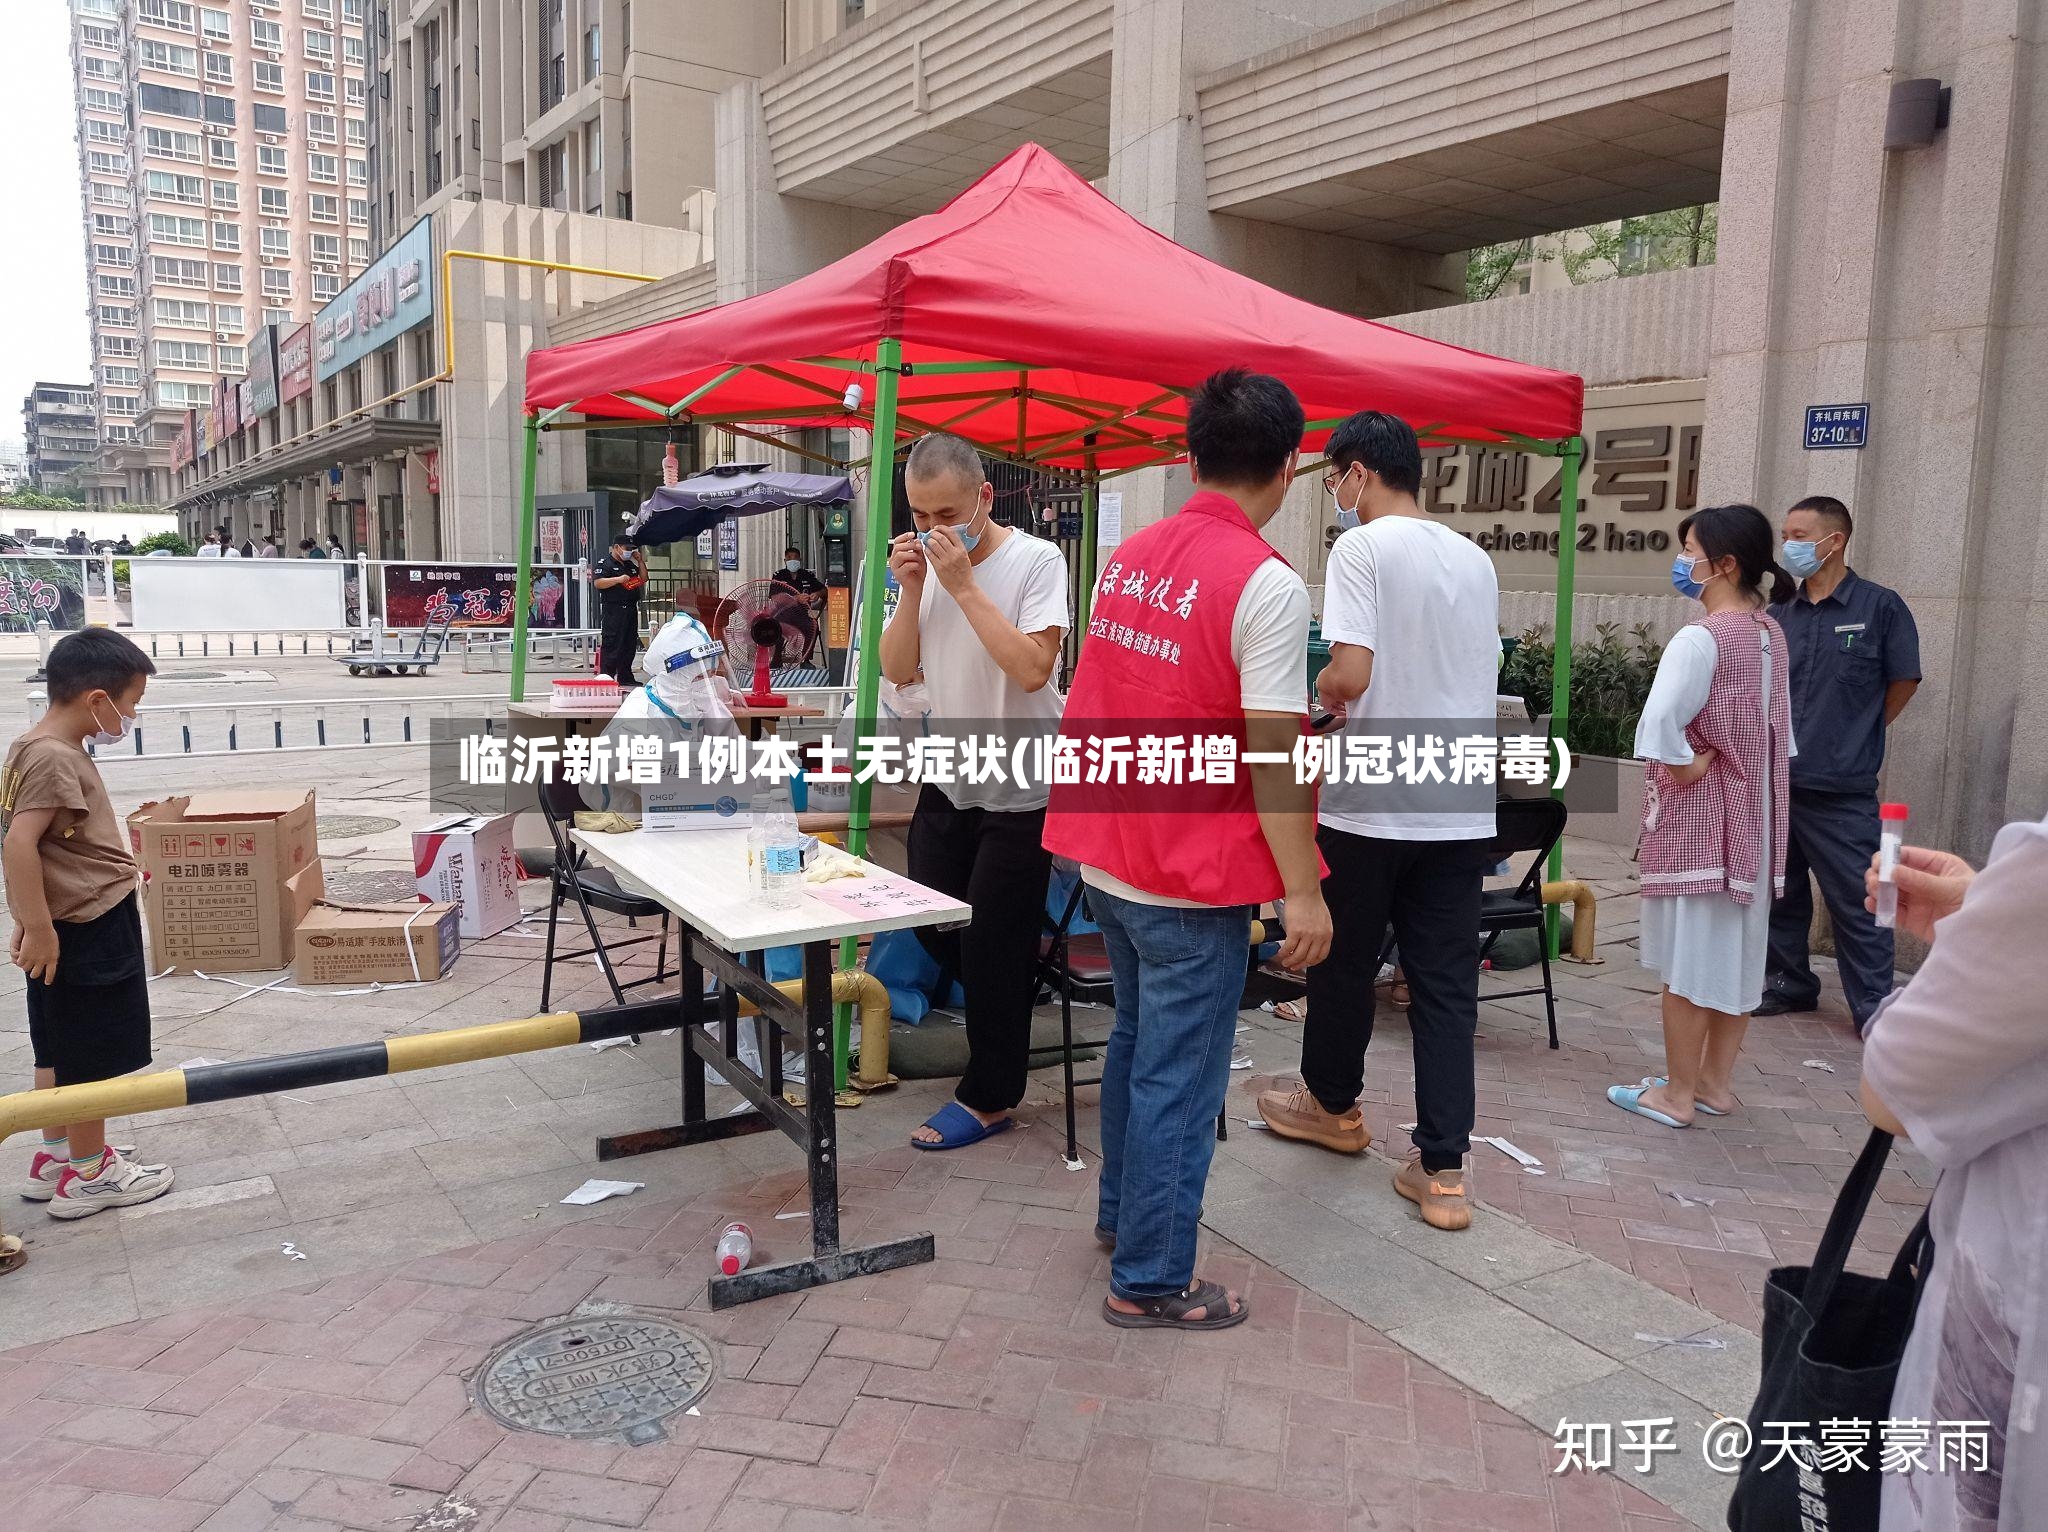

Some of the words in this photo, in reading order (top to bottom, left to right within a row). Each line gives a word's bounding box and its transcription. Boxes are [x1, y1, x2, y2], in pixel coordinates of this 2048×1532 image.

[1811, 427, 1845, 443] 37-10
[1577, 523, 1597, 552] 2
[1604, 522, 1669, 552] hao
[168, 862, 249, 878] 电动喷雾器
